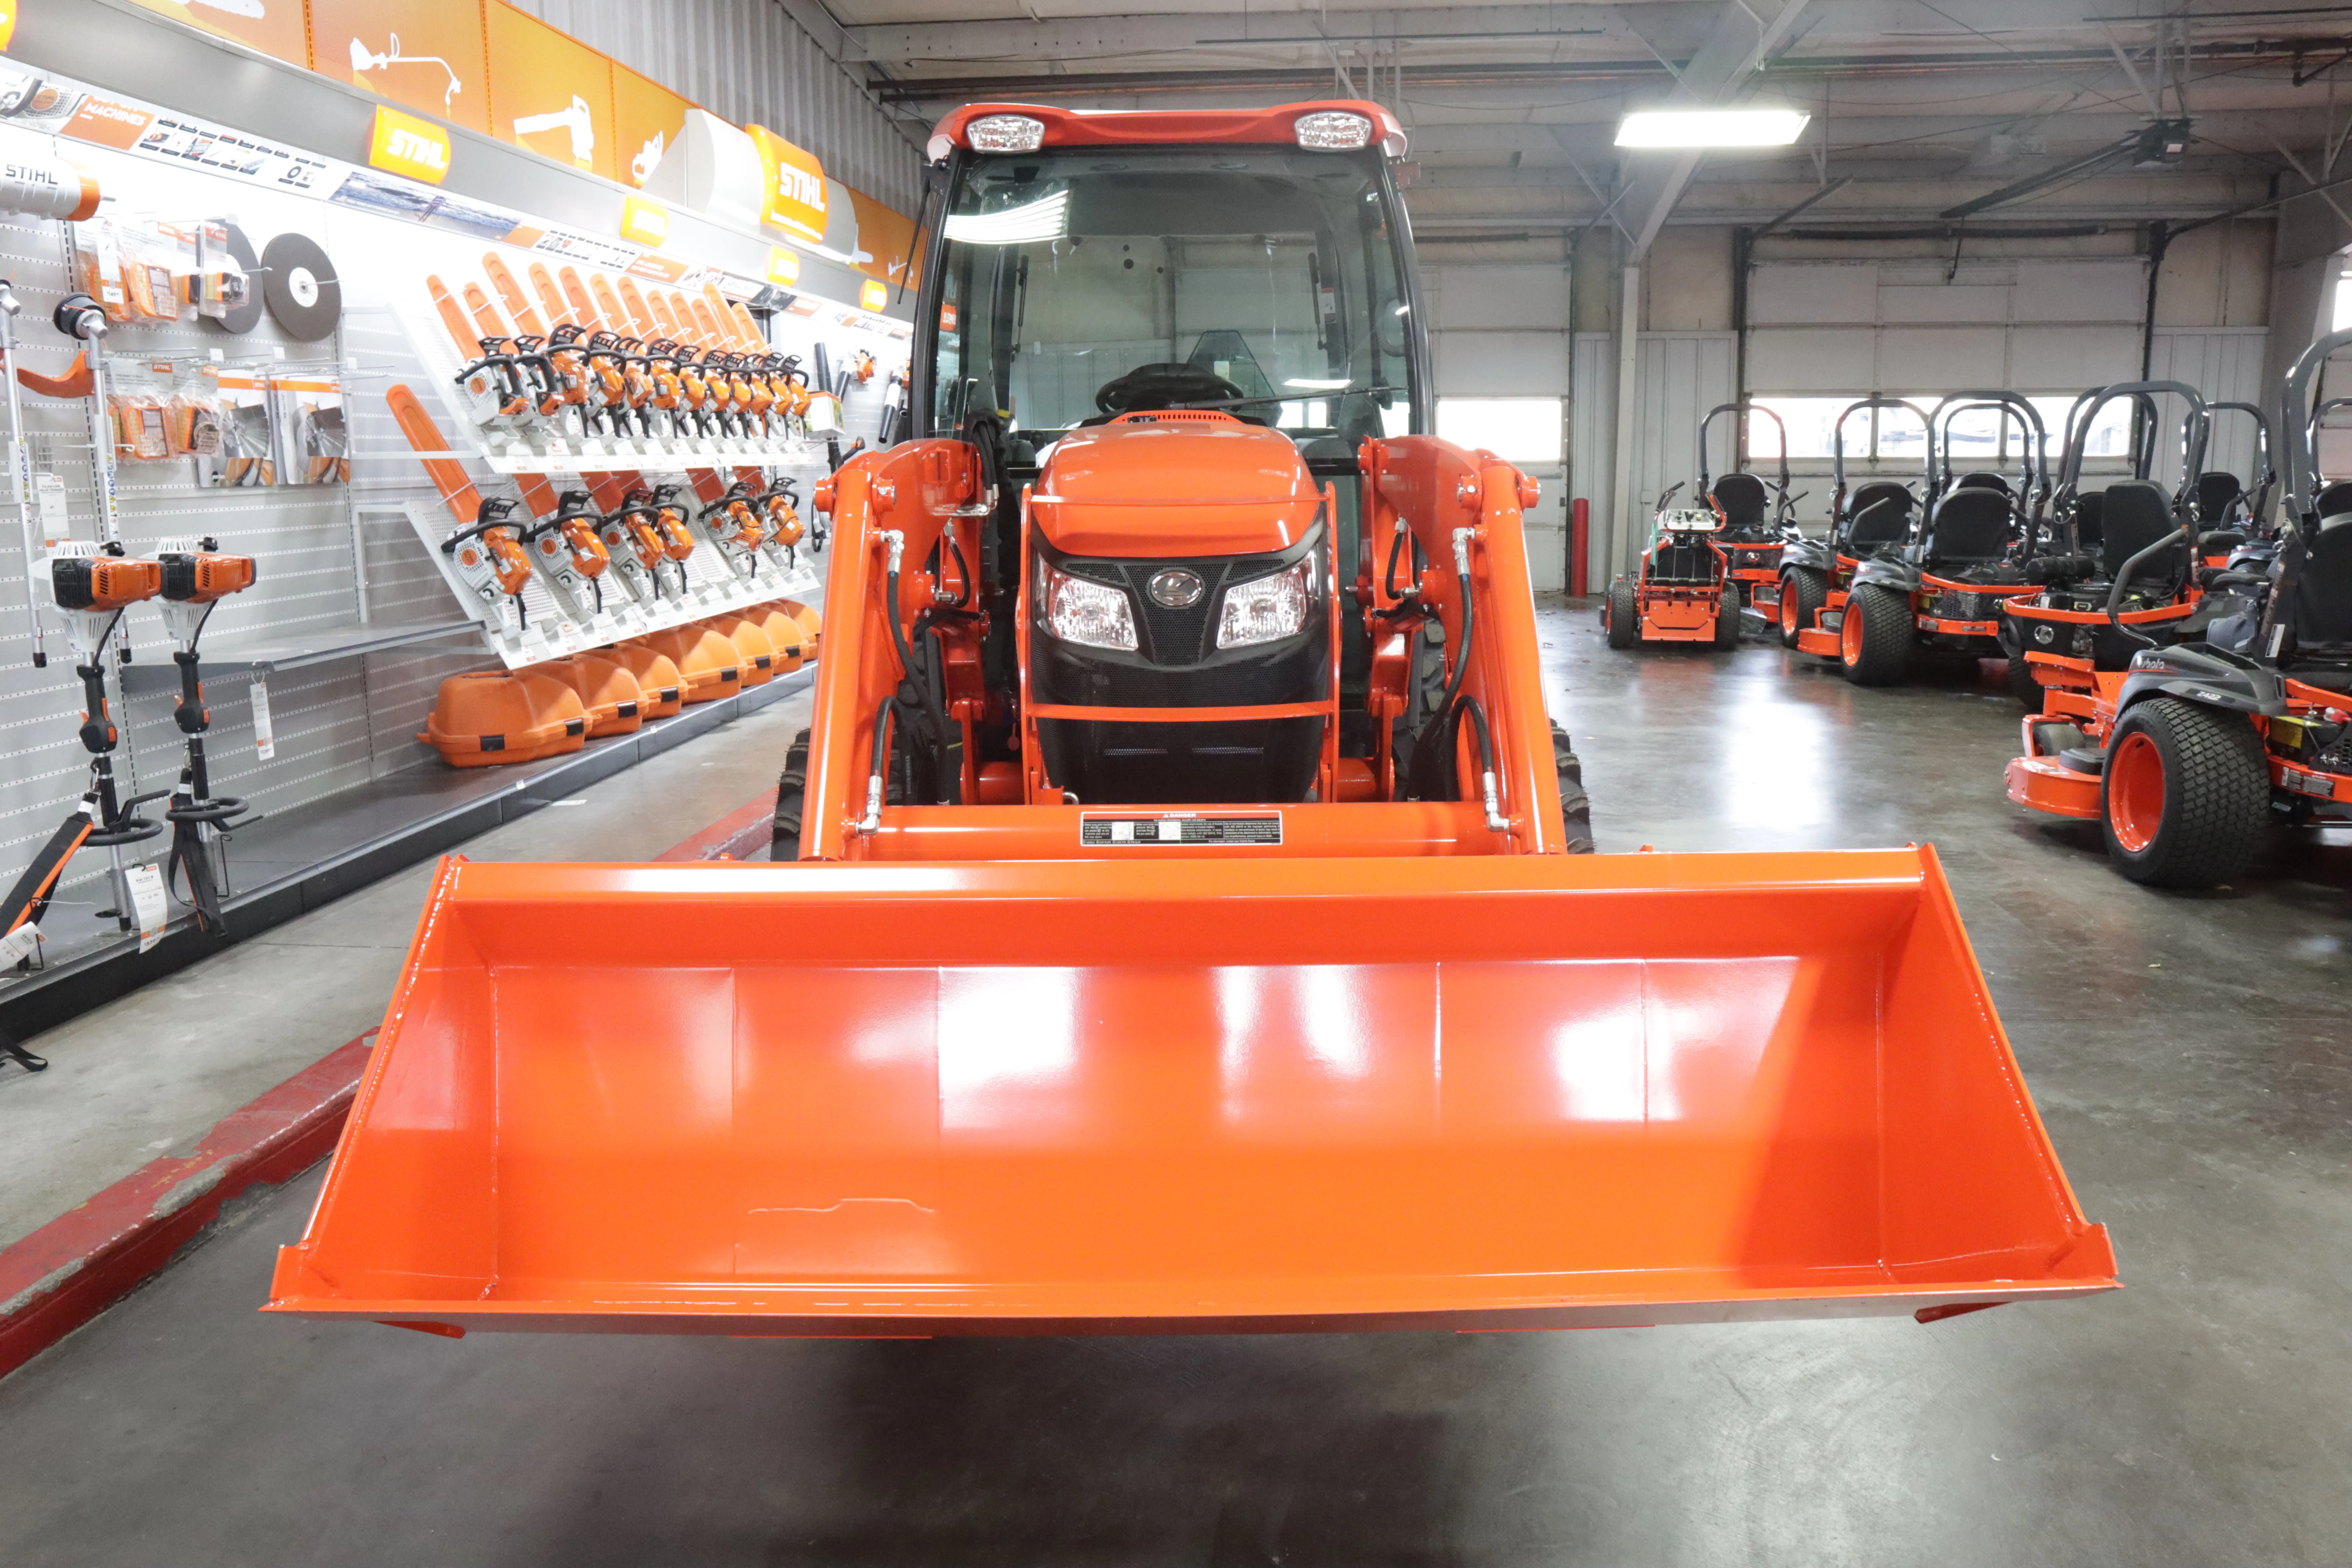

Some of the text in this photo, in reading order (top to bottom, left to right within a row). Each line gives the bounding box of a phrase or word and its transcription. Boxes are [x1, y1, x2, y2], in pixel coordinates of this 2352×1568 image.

[84, 102, 146, 126] MACHINES
[387, 129, 446, 169] STIHL
[5, 163, 58, 185] STIHL
[780, 162, 825, 212] STIHL
[632, 209, 667, 237] STIHL
